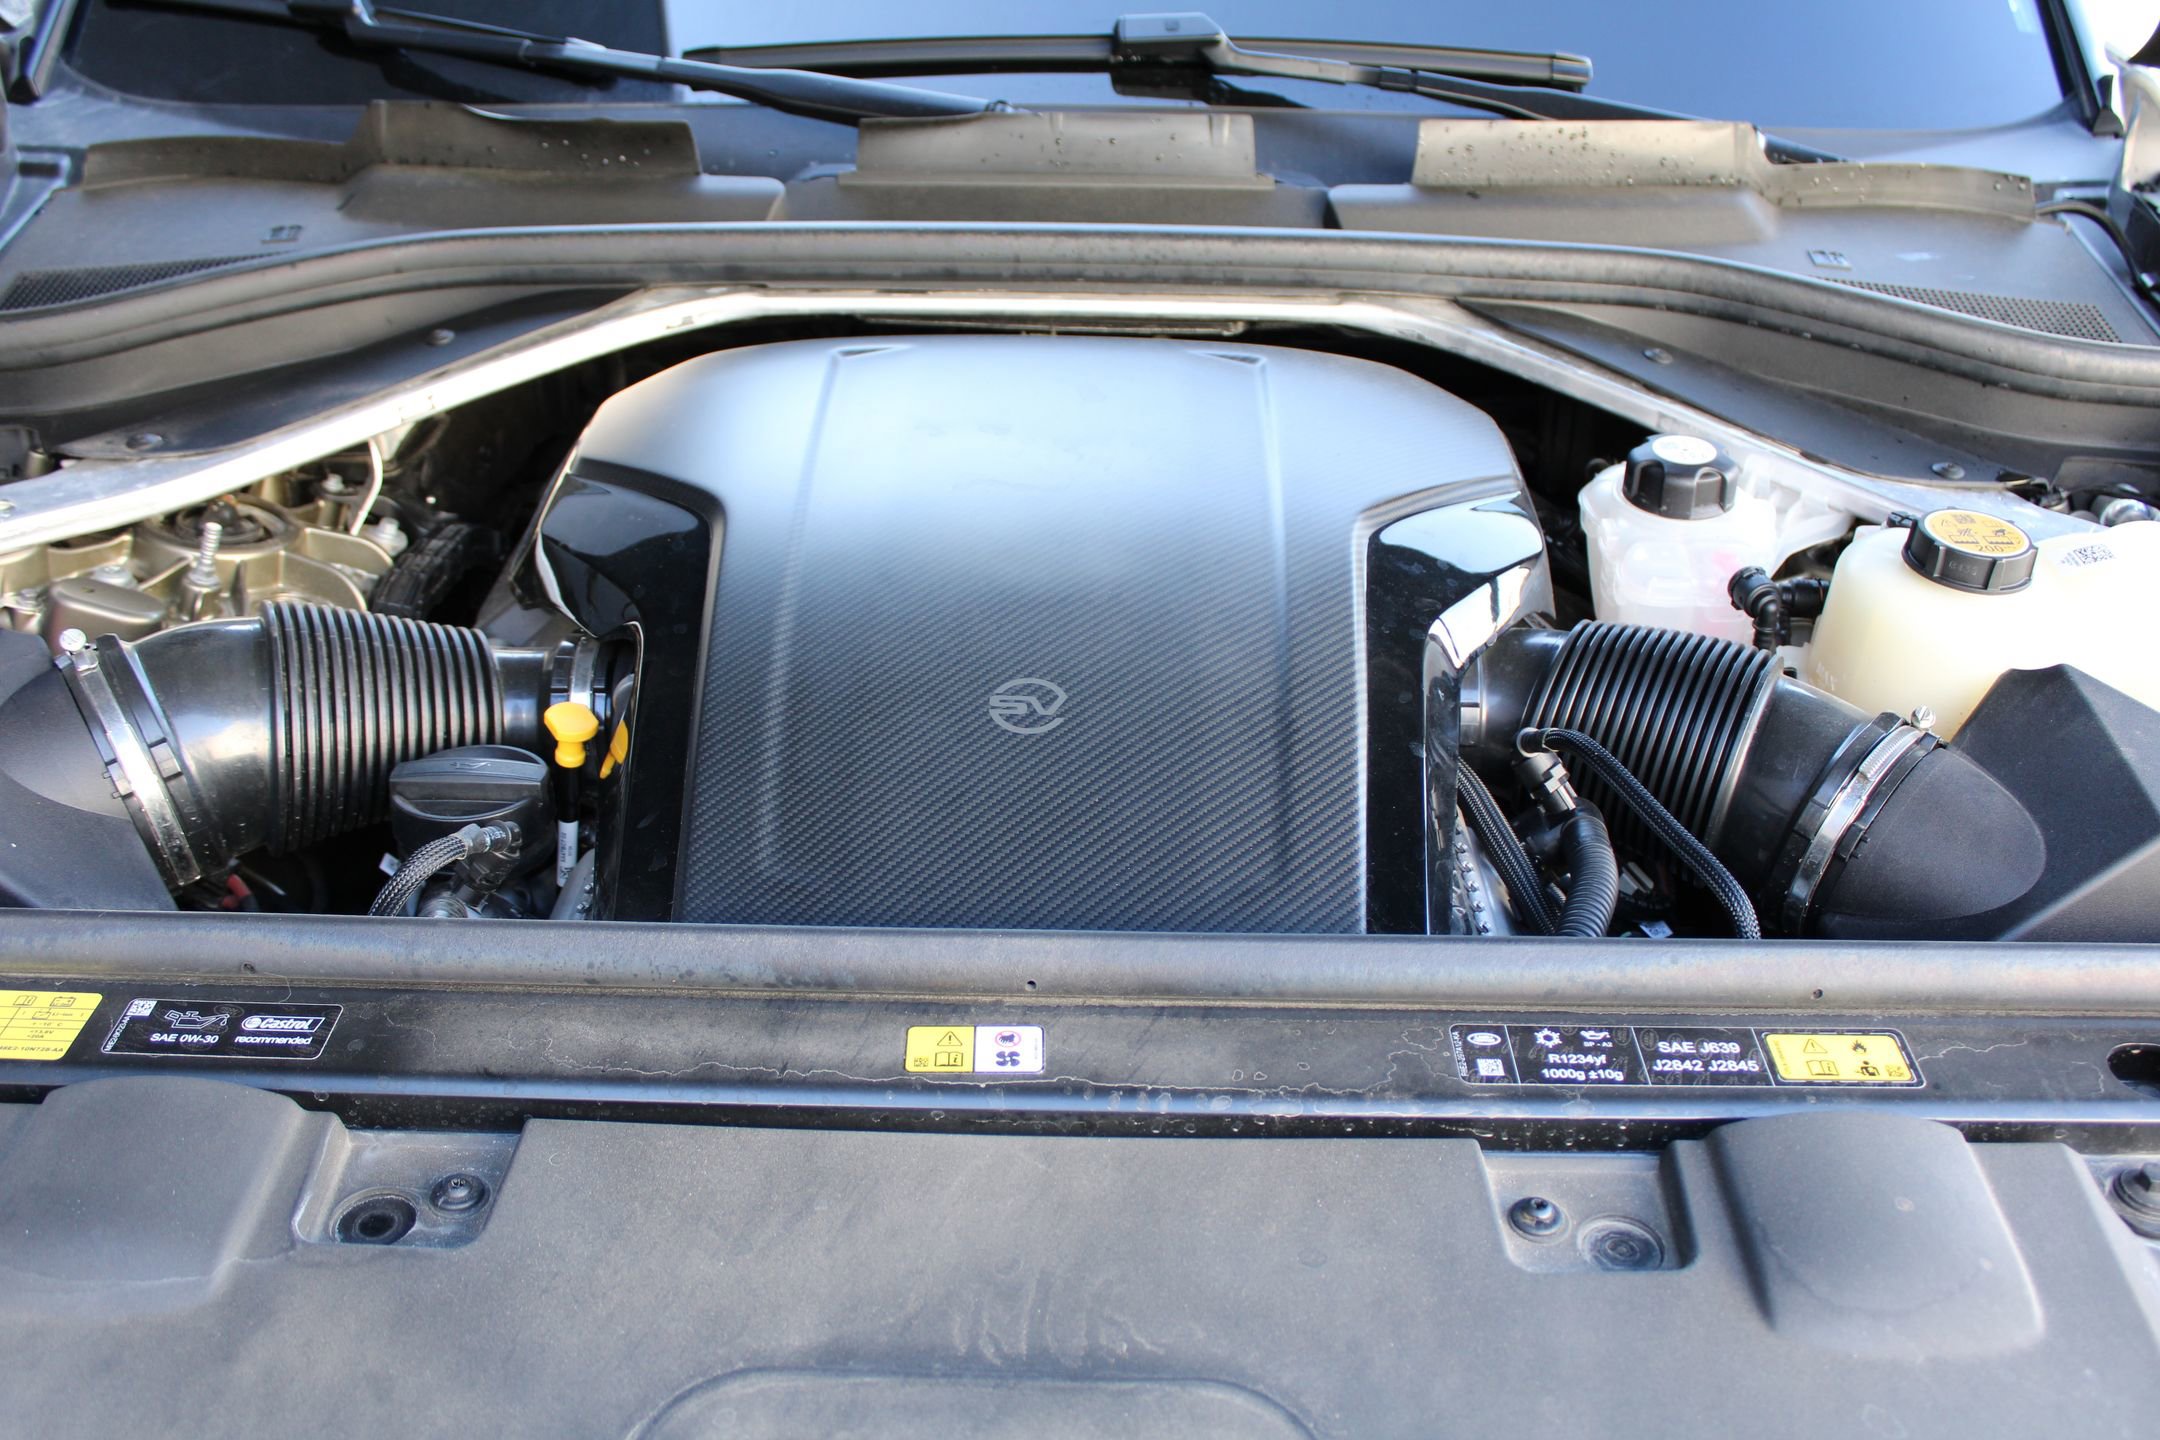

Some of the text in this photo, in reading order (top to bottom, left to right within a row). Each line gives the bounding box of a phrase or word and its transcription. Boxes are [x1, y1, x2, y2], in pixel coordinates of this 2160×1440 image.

[260, 1018, 314, 1030] Castrol
[150, 1033, 219, 1044] SAE 0W-30
[234, 1036, 313, 1045] recommended
[1658, 1041, 1741, 1053] SAE J639
[1547, 1053, 1607, 1066] R1234yf
[1652, 1059, 1760, 1071] J2842 J2845
[1541, 1068, 1624, 1081] 1000g ±10g
